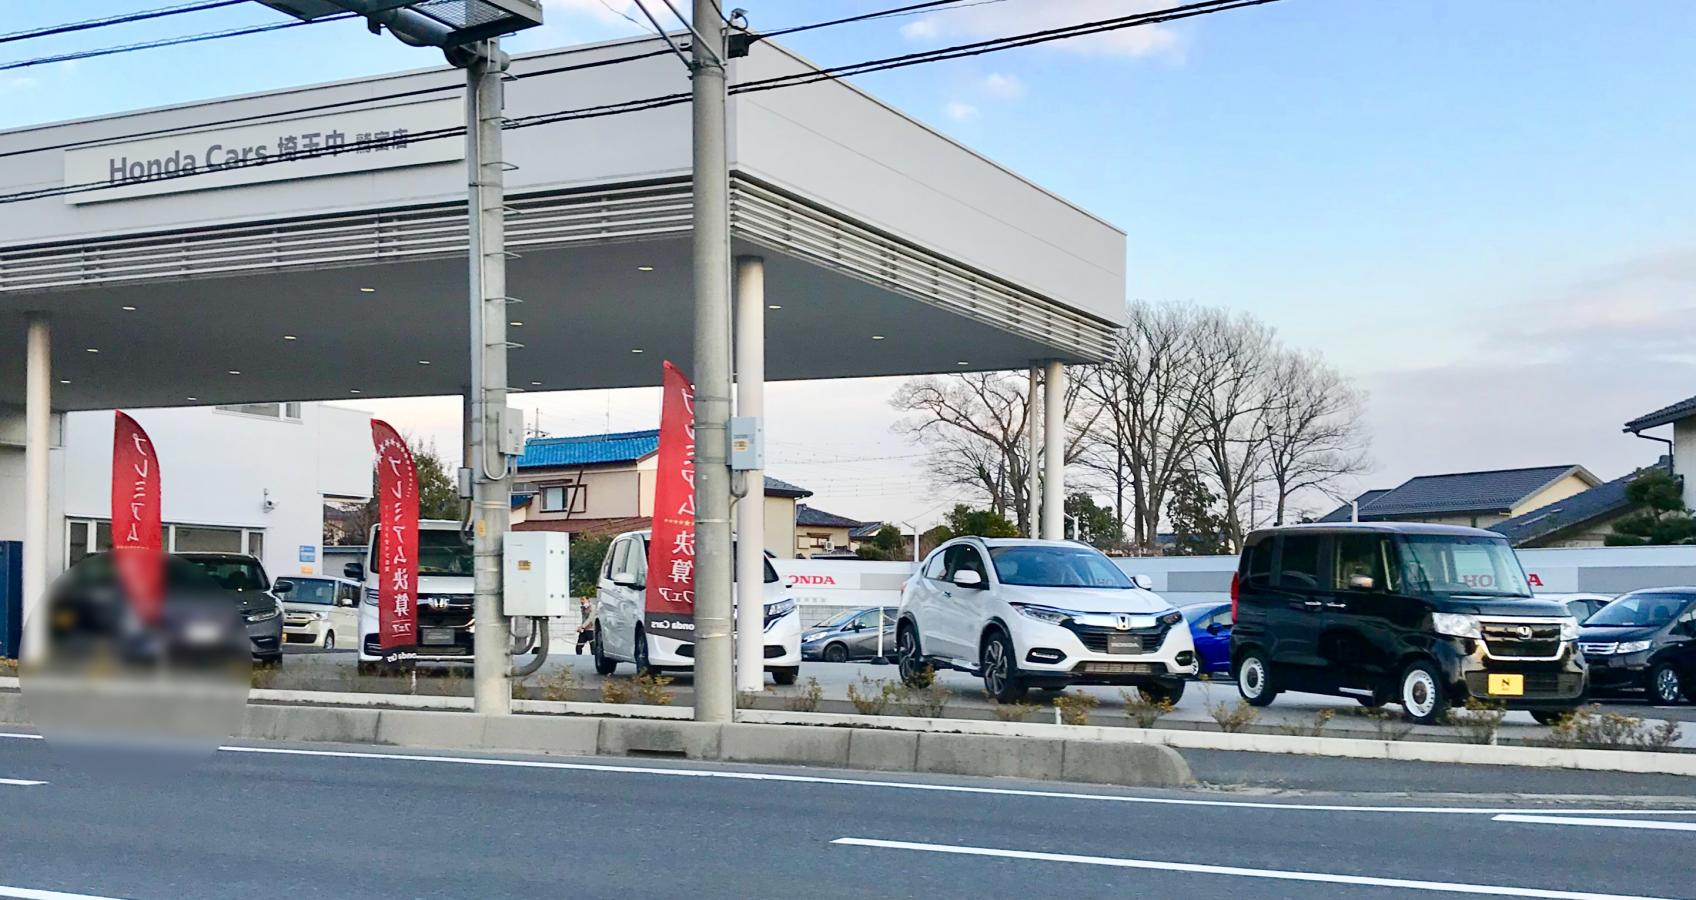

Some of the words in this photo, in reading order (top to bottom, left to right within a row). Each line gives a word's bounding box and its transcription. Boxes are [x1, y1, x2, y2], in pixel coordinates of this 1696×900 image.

[110, 150, 196, 184] Honda
[205, 144, 267, 170] Cars
[278, 129, 345, 161] 埼玉中
[788, 575, 836, 585] ONDA
